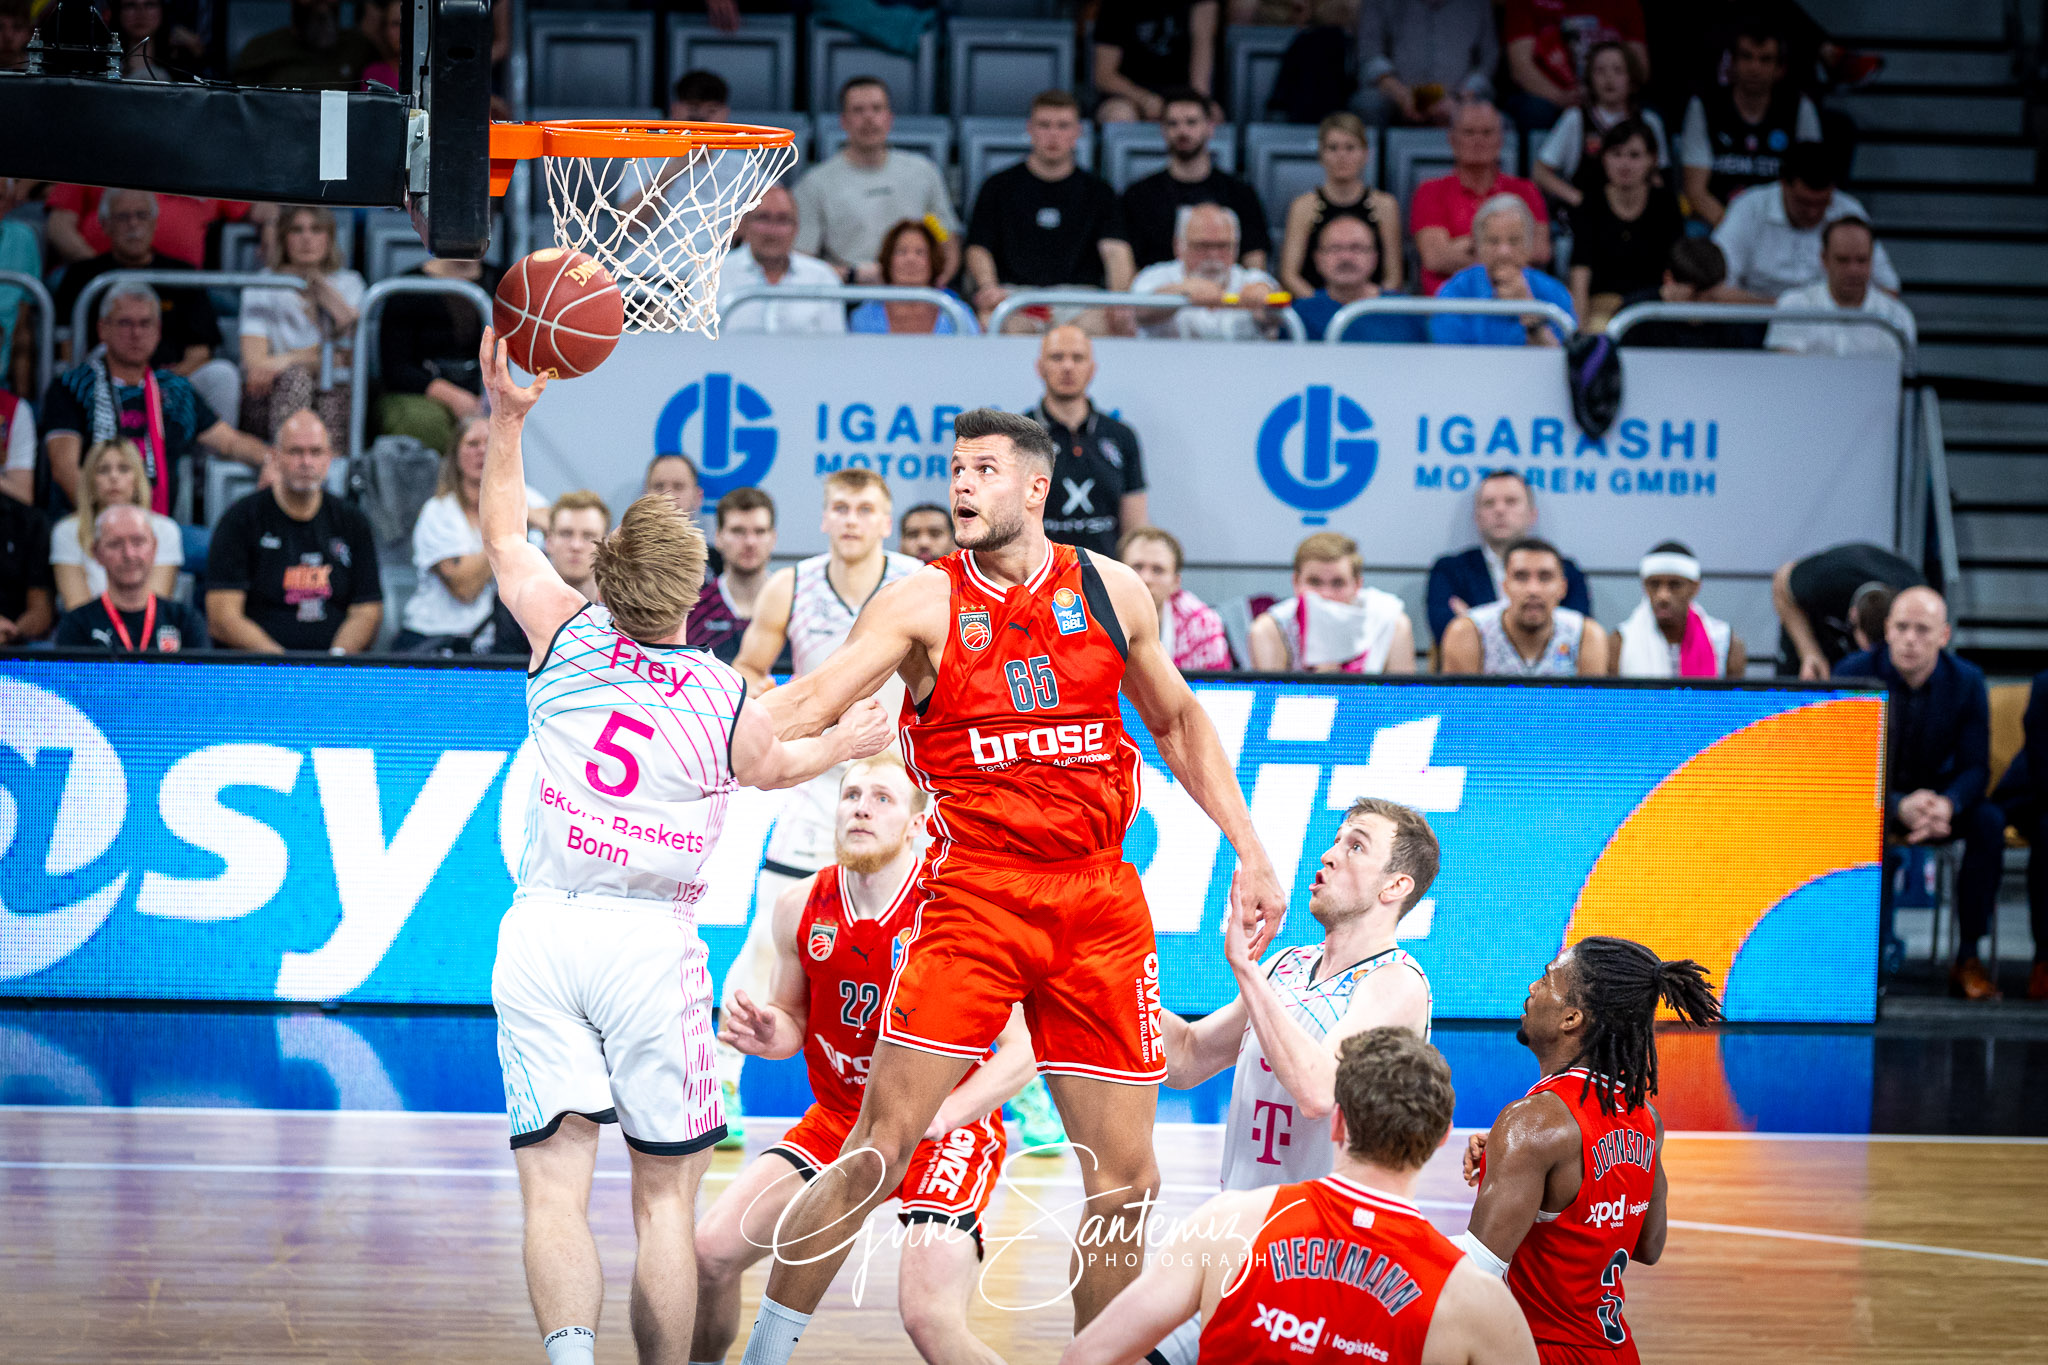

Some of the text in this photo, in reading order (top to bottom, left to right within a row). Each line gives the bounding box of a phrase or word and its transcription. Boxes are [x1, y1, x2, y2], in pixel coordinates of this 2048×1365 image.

[1062, 617, 1085, 631] BBL
[609, 637, 692, 698] Frey
[1004, 655, 1060, 713] 65
[585, 711, 655, 797] 5
[968, 722, 1104, 765] brose
[567, 825, 628, 866] Bonn
[612, 816, 703, 853] Baskets
[839, 980, 880, 1028] 22
[815, 1033, 872, 1074] bro
[1592, 1128, 1656, 1181] JOHNSON
[1585, 1194, 1626, 1228] xpd
[1268, 1236, 1422, 1317] HECKMANN
[1251, 1302, 1389, 1362] xpd logistics
